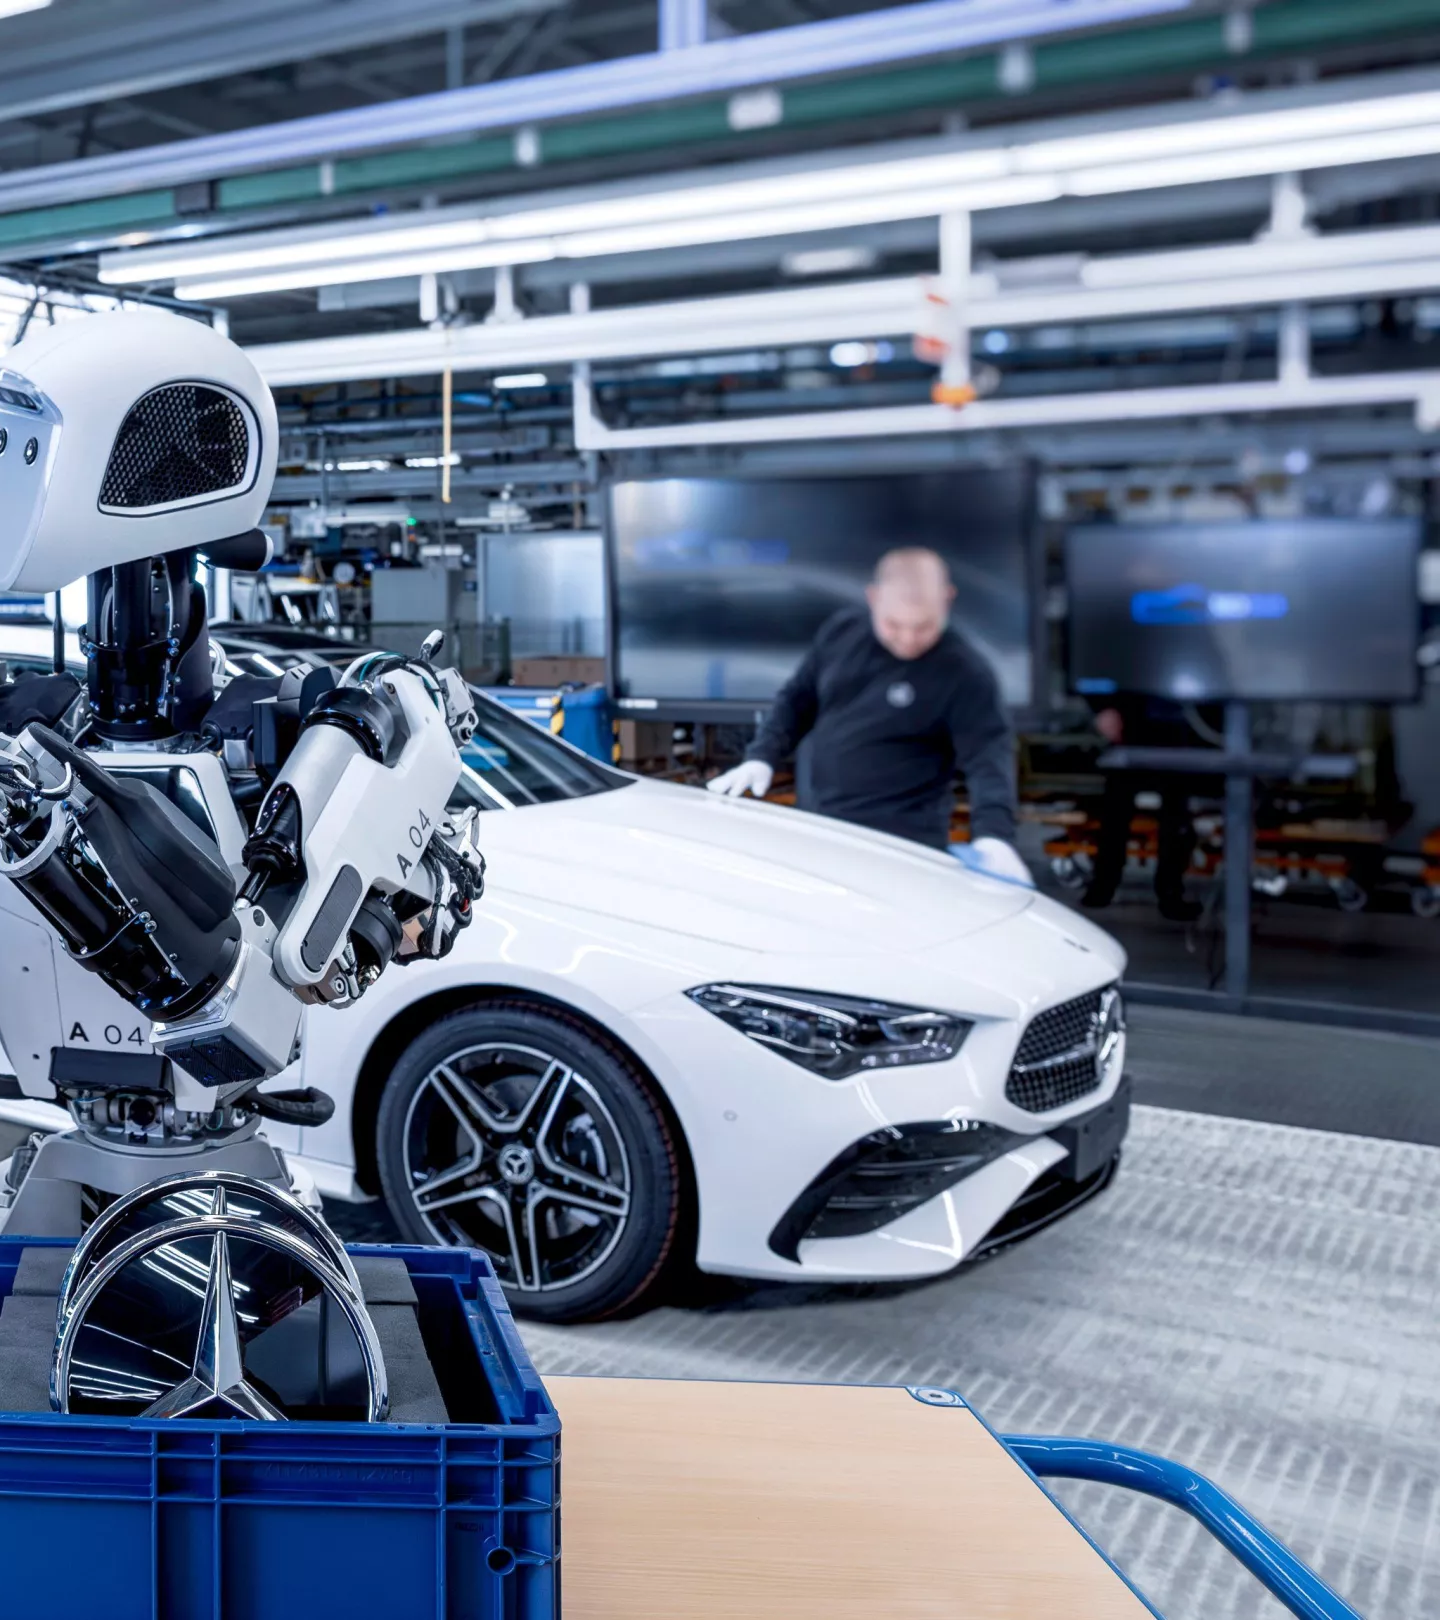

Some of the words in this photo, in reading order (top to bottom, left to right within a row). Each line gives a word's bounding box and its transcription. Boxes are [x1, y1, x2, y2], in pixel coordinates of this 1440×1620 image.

[396, 853, 413, 880] A
[409, 808, 431, 849] 04
[69, 1021, 90, 1042] A
[104, 1024, 145, 1047] 04
